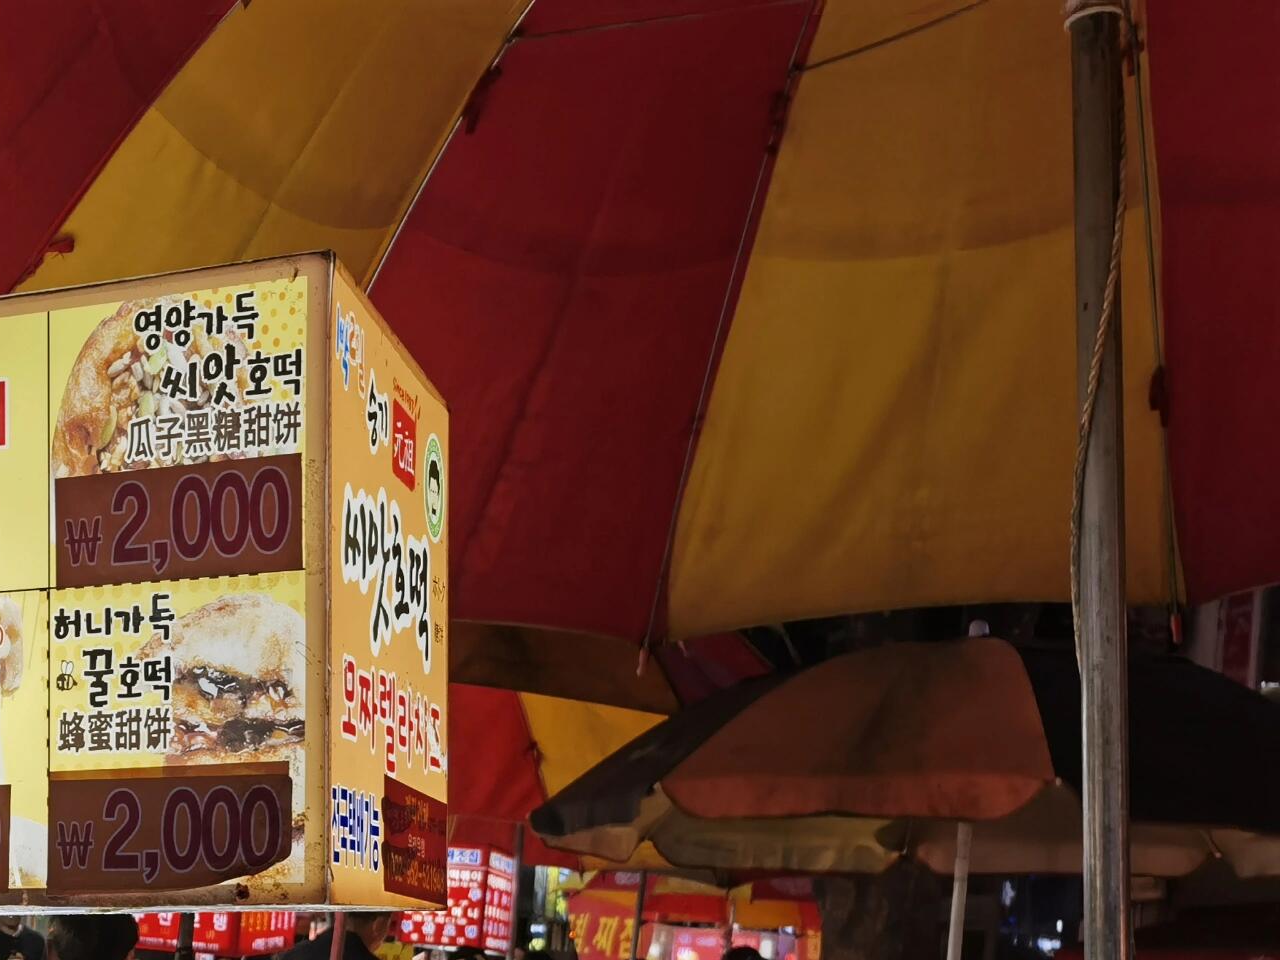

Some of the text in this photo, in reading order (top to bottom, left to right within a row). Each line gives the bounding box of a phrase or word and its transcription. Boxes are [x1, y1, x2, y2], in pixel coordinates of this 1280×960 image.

[133, 290, 260, 351] 영양가득
[161, 346, 303, 404] 씨앗호떡
[125, 402, 303, 463] 瓜子黑糖甜饼
[366, 376, 416, 476] 승기 元祖
[53, 593, 175, 642] 허니가득
[82, 648, 173, 709] 꿀호떡
[58, 708, 173, 754] 蜂蜜甜饼
